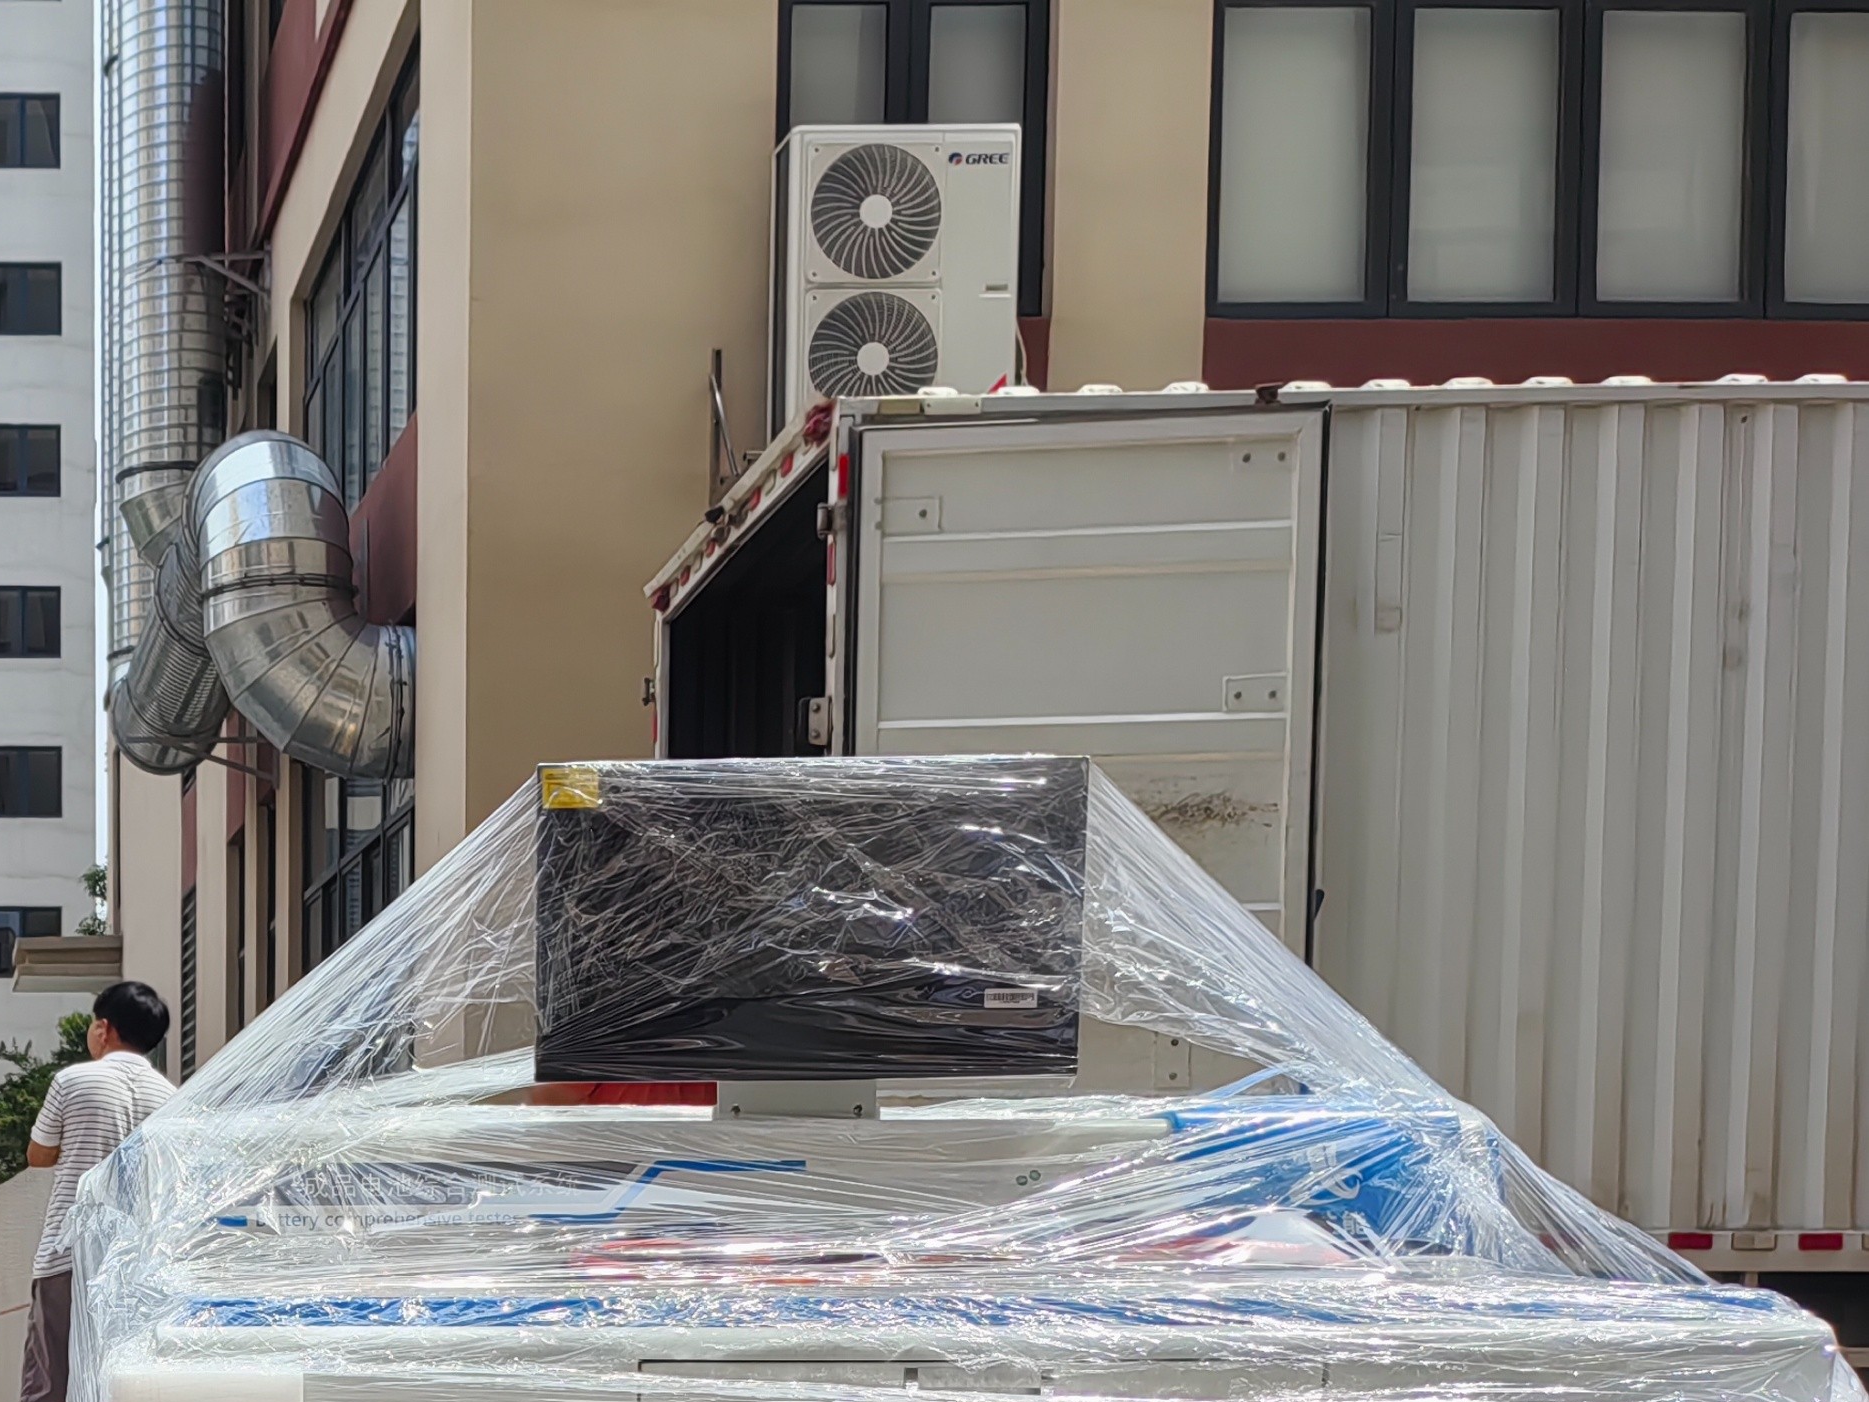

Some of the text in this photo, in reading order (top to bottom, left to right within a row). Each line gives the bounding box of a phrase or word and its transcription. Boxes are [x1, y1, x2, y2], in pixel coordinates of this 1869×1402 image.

[965, 152, 1010, 165] GREE
[256, 1211, 319, 1231] Bttery
[468, 1211, 520, 1223] teste
